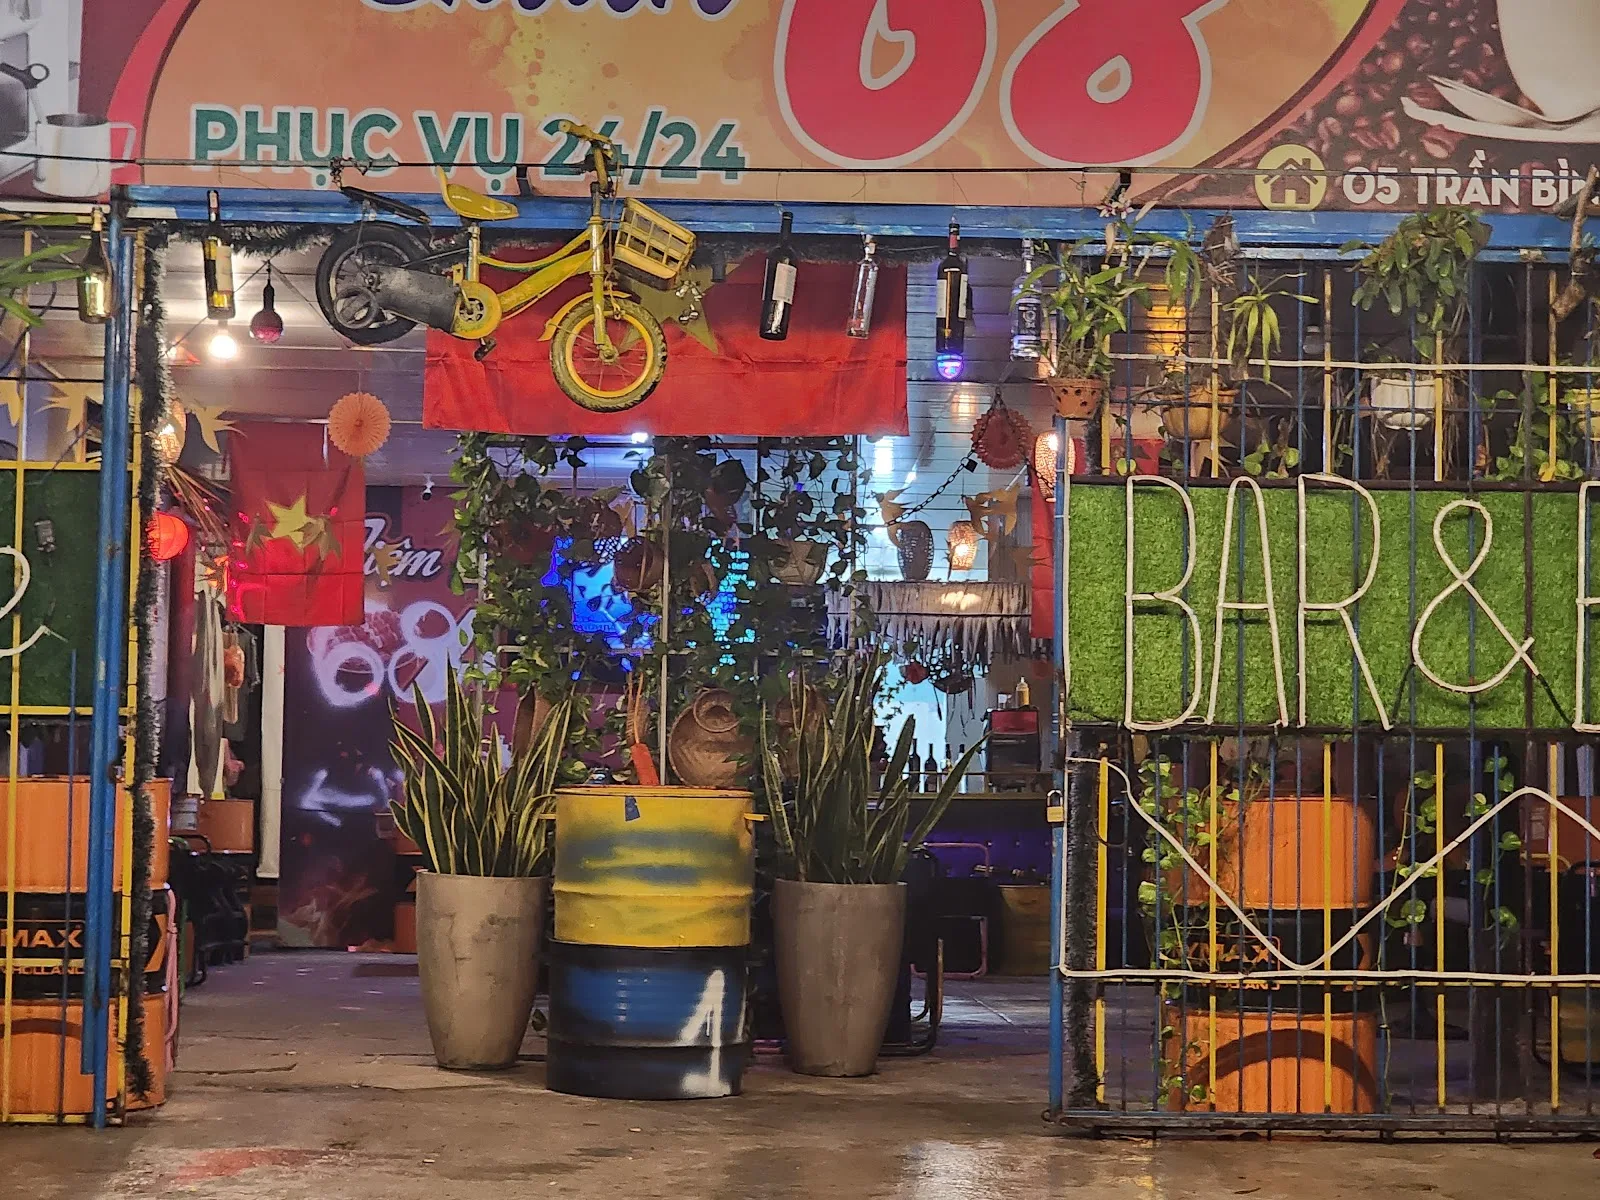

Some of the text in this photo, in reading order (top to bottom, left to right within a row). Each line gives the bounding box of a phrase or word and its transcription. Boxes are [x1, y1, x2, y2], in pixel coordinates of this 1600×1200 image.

[192, 104, 746, 191] PHỤC VỤ 24/24
[1411, 149, 1520, 206] TRẦN
[1126, 473, 1396, 731] BAR
[1412, 499, 1539, 693] &
